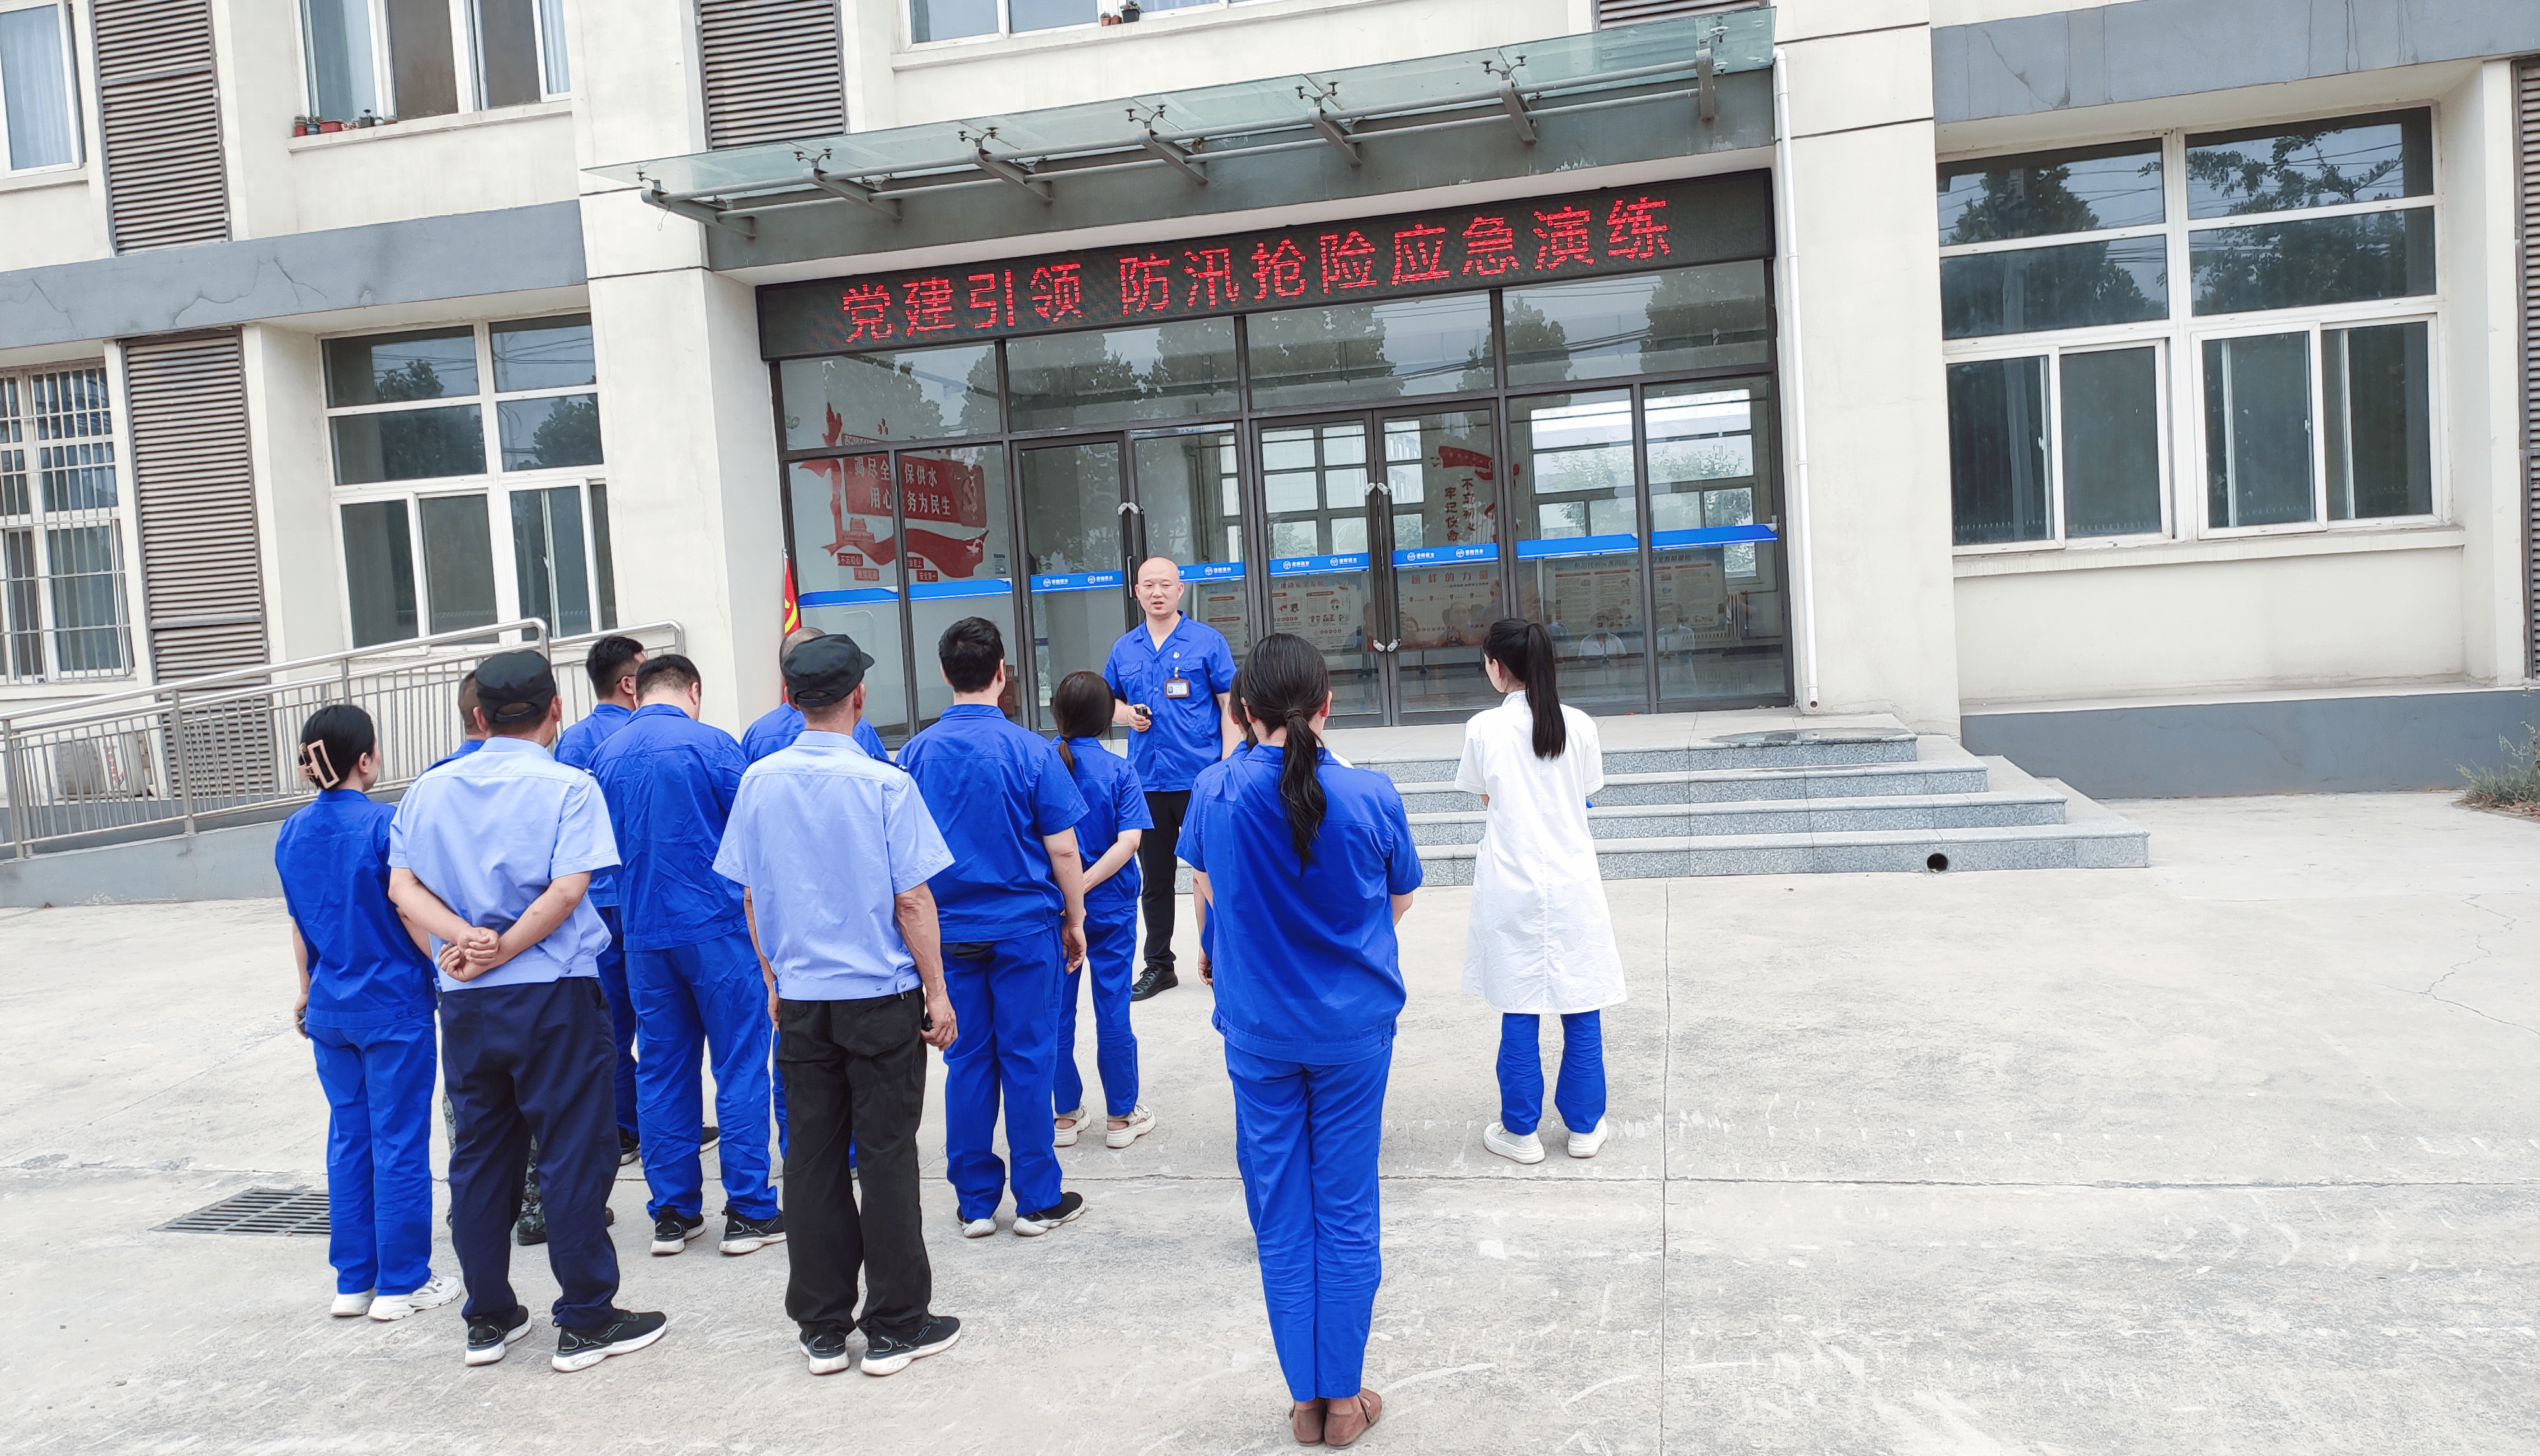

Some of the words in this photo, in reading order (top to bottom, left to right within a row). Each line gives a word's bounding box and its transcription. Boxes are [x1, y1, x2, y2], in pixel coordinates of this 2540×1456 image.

[842, 262, 1082, 344] 党建引领
[1119, 195, 1673, 316] 防汛抢险应急演练
[855, 457, 937, 487] 竭尽全保供水
[871, 486, 951, 515] 用心务为民生
[1445, 486, 1459, 541] 牢记使命
